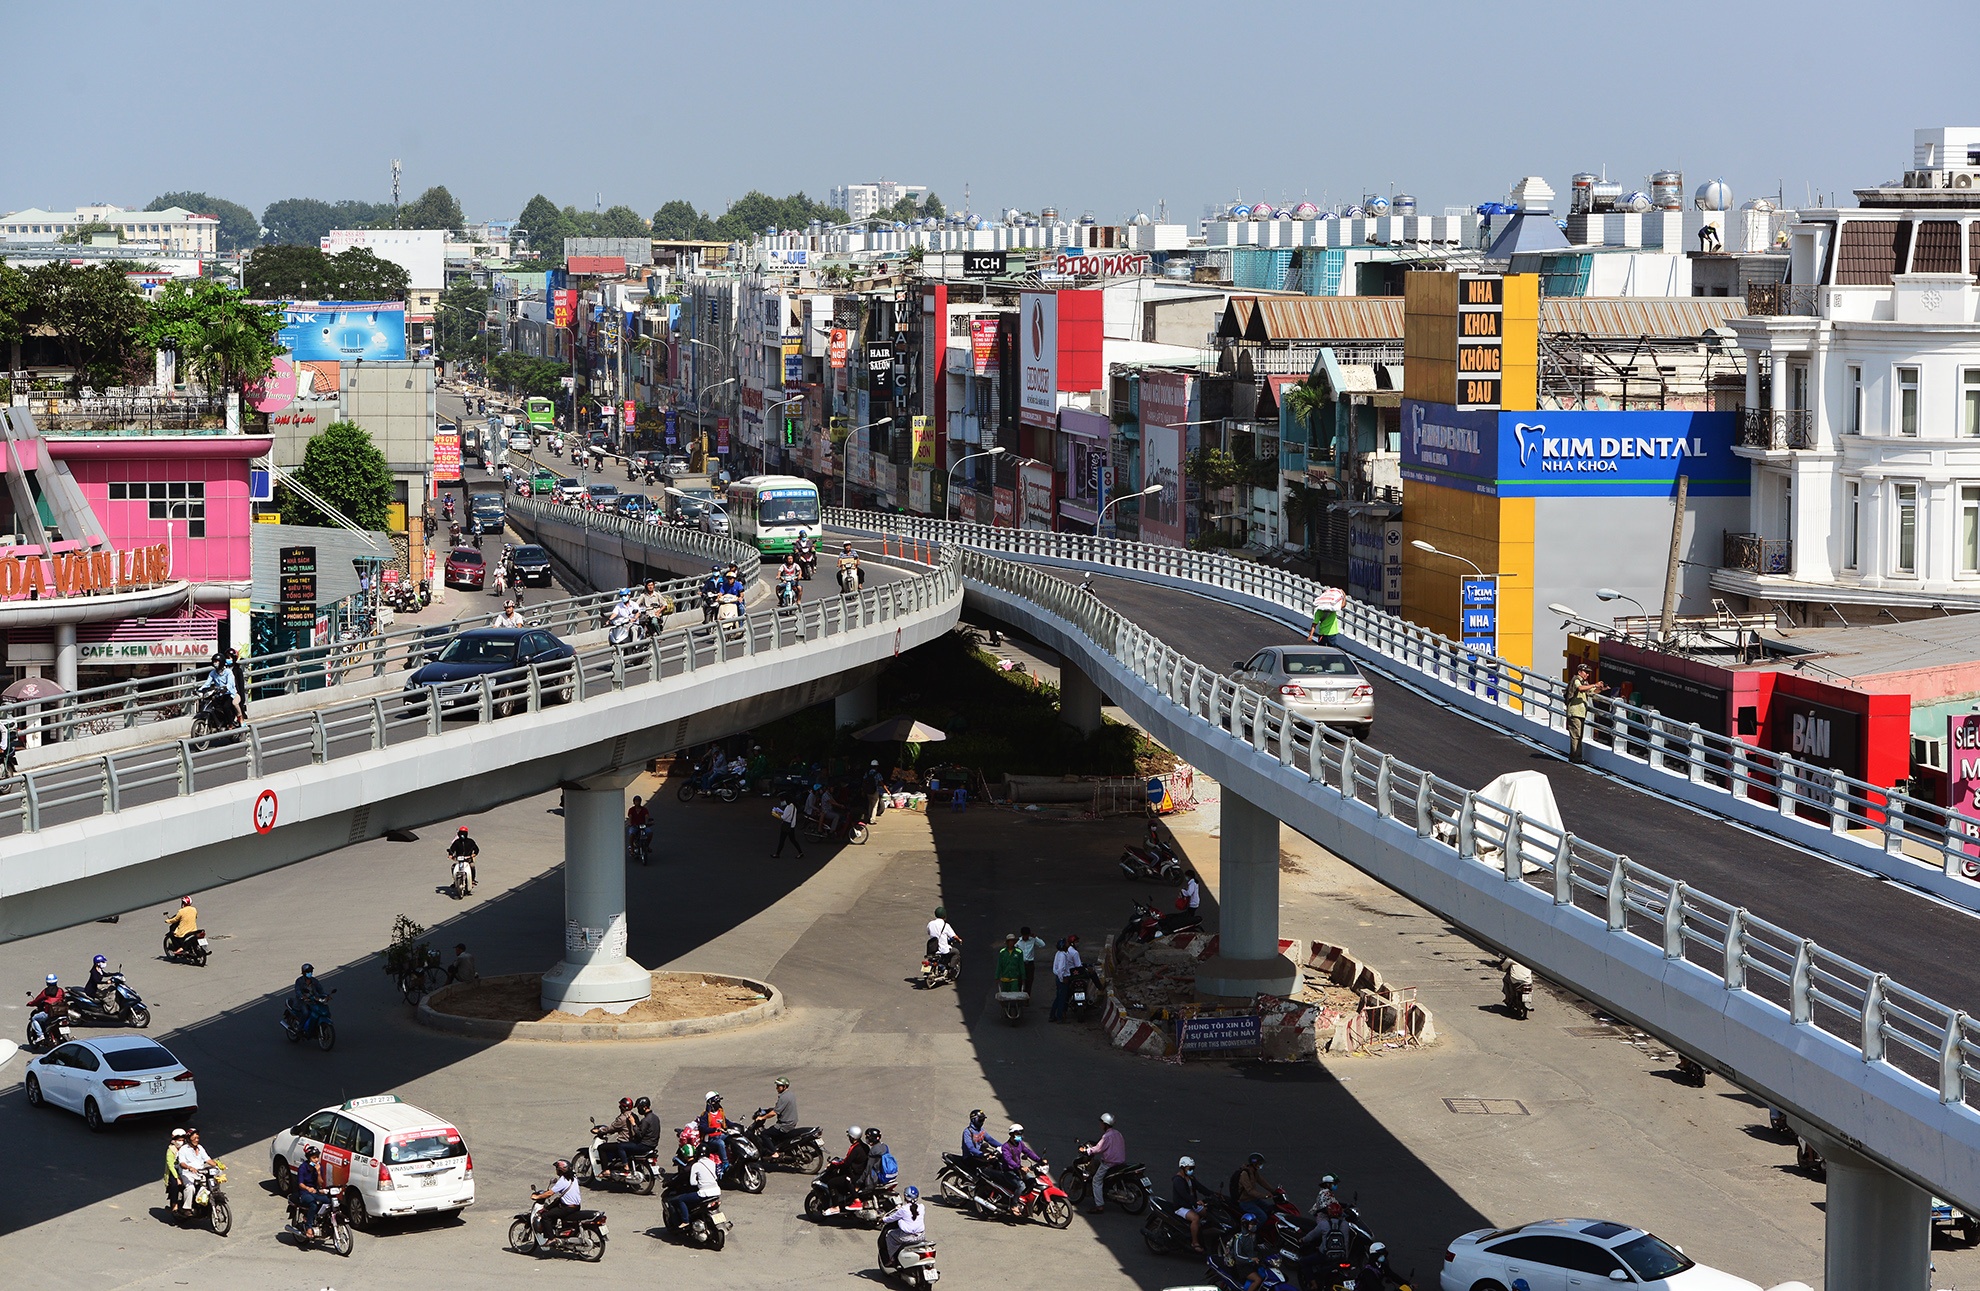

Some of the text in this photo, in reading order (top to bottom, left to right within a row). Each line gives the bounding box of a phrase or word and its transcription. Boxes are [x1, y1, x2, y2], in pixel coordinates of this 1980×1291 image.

[1057, 254, 1148, 276] BIBO MART
[1469, 281, 1493, 303] NHA
[555, 307, 568, 317] CA
[556, 317, 567, 327] LI
[1464, 313, 1496, 335] KHOA
[832, 341, 846, 349] ANH
[832, 350, 846, 359] NGỮ
[870, 349, 890, 358] HAIR
[1460, 345, 1500, 371] KHÔNG
[870, 360, 891, 371] SALON
[1467, 381, 1492, 403] ĐAU
[914, 430, 934, 443] THANH
[918, 445, 931, 458] SƠN
[1542, 436, 1708, 459] KIM DENTAL
[1542, 459, 1618, 473] NHA KHOA
[1104, 471, 1112, 486] GO
[52, 546, 111, 592] VĂN
[119, 543, 169, 587] LANG
[1474, 588, 1492, 597] KIM
[1469, 614, 1489, 628] NHA
[81, 643, 114, 657] CAFÉ
[121, 645, 148, 656] KEM
[149, 643, 173, 656] VĂN
[175, 644, 209, 656] LANG
[1792, 710, 1831, 759] BÁN
[1240, 1019, 1254, 1028] LỖI
[1190, 1032, 1201, 1040] SỰ
[1203, 1030, 1218, 1039] BẤT
[1220, 1030, 1239, 1038] TIỆN
[1240, 1029, 1256, 1037] NÀY
[1220, 1038, 1257, 1047] INCONVENIENCE
